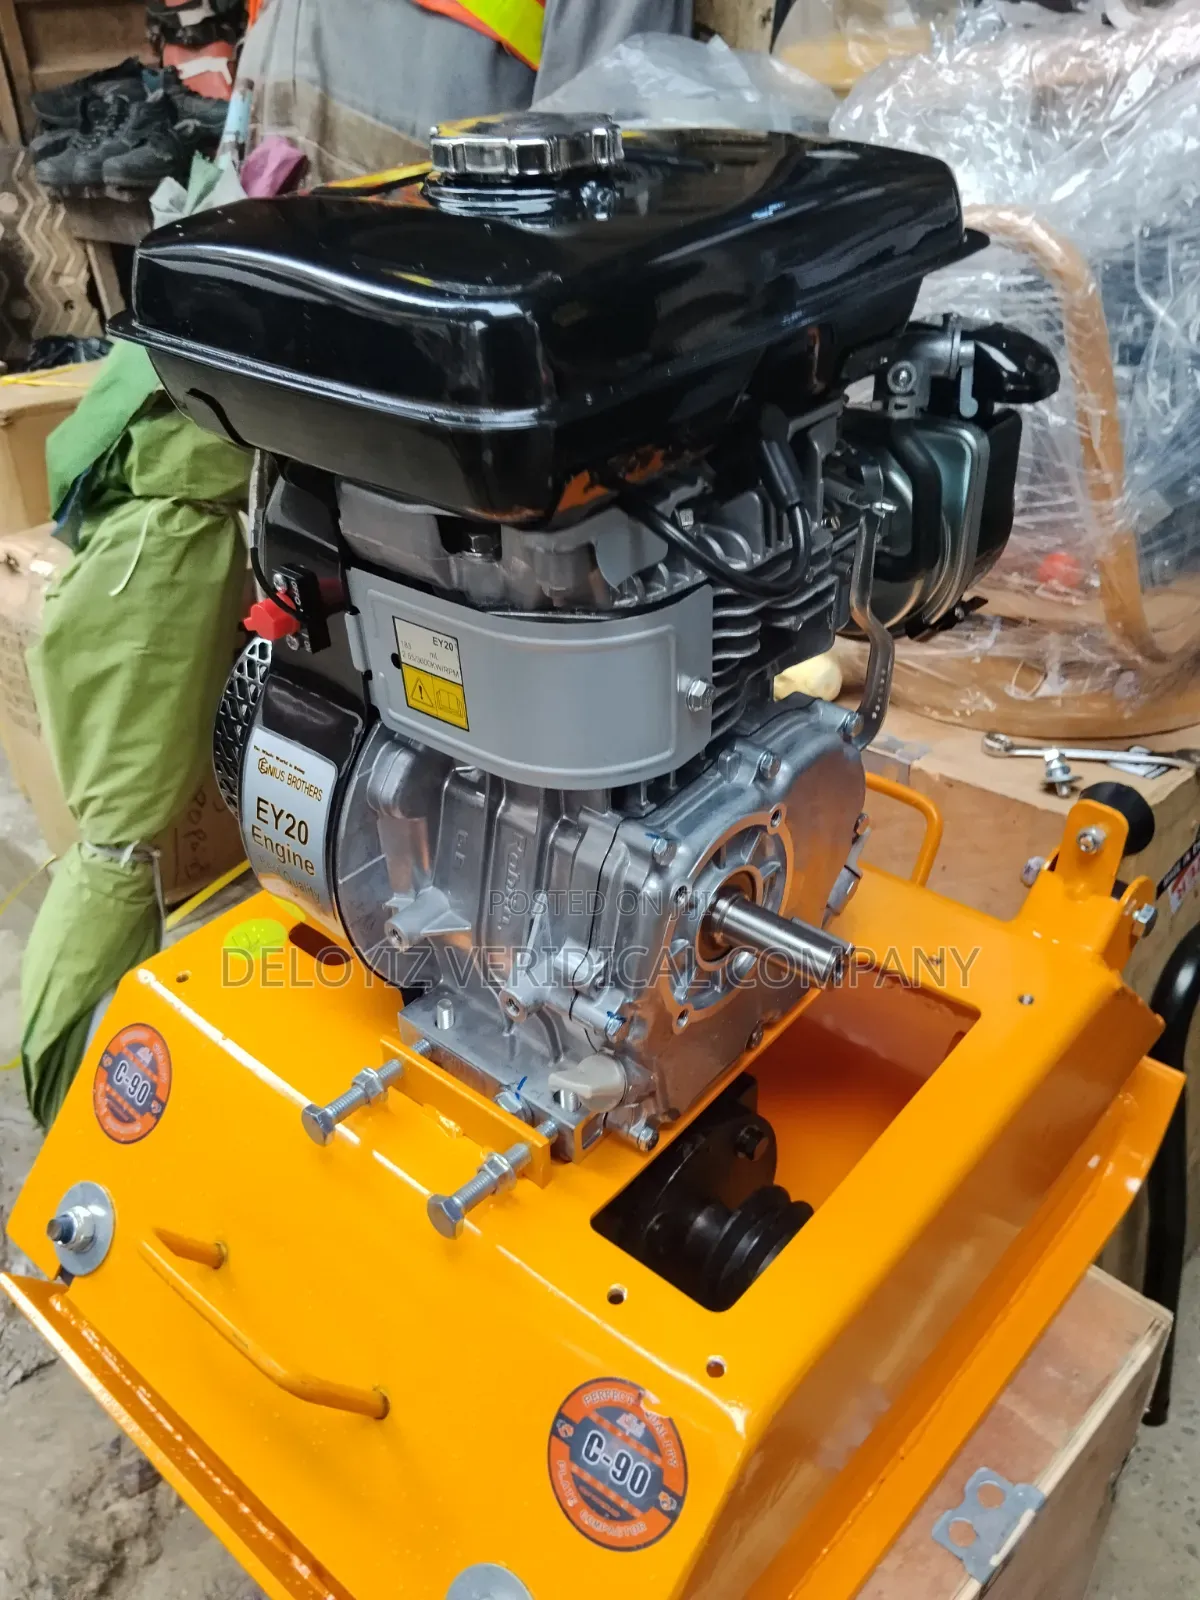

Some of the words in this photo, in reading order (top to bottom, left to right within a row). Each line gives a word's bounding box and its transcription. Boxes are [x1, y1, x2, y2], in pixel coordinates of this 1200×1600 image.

[432, 636, 454, 652] EY20
[287, 773, 323, 802] BROTHERS
[256, 796, 309, 847] EY20
[251, 823, 315, 876] Engine
[114, 1060, 150, 1105] C-90
[583, 1388, 635, 1406] PERFECT
[582, 1430, 651, 1497] C-90
